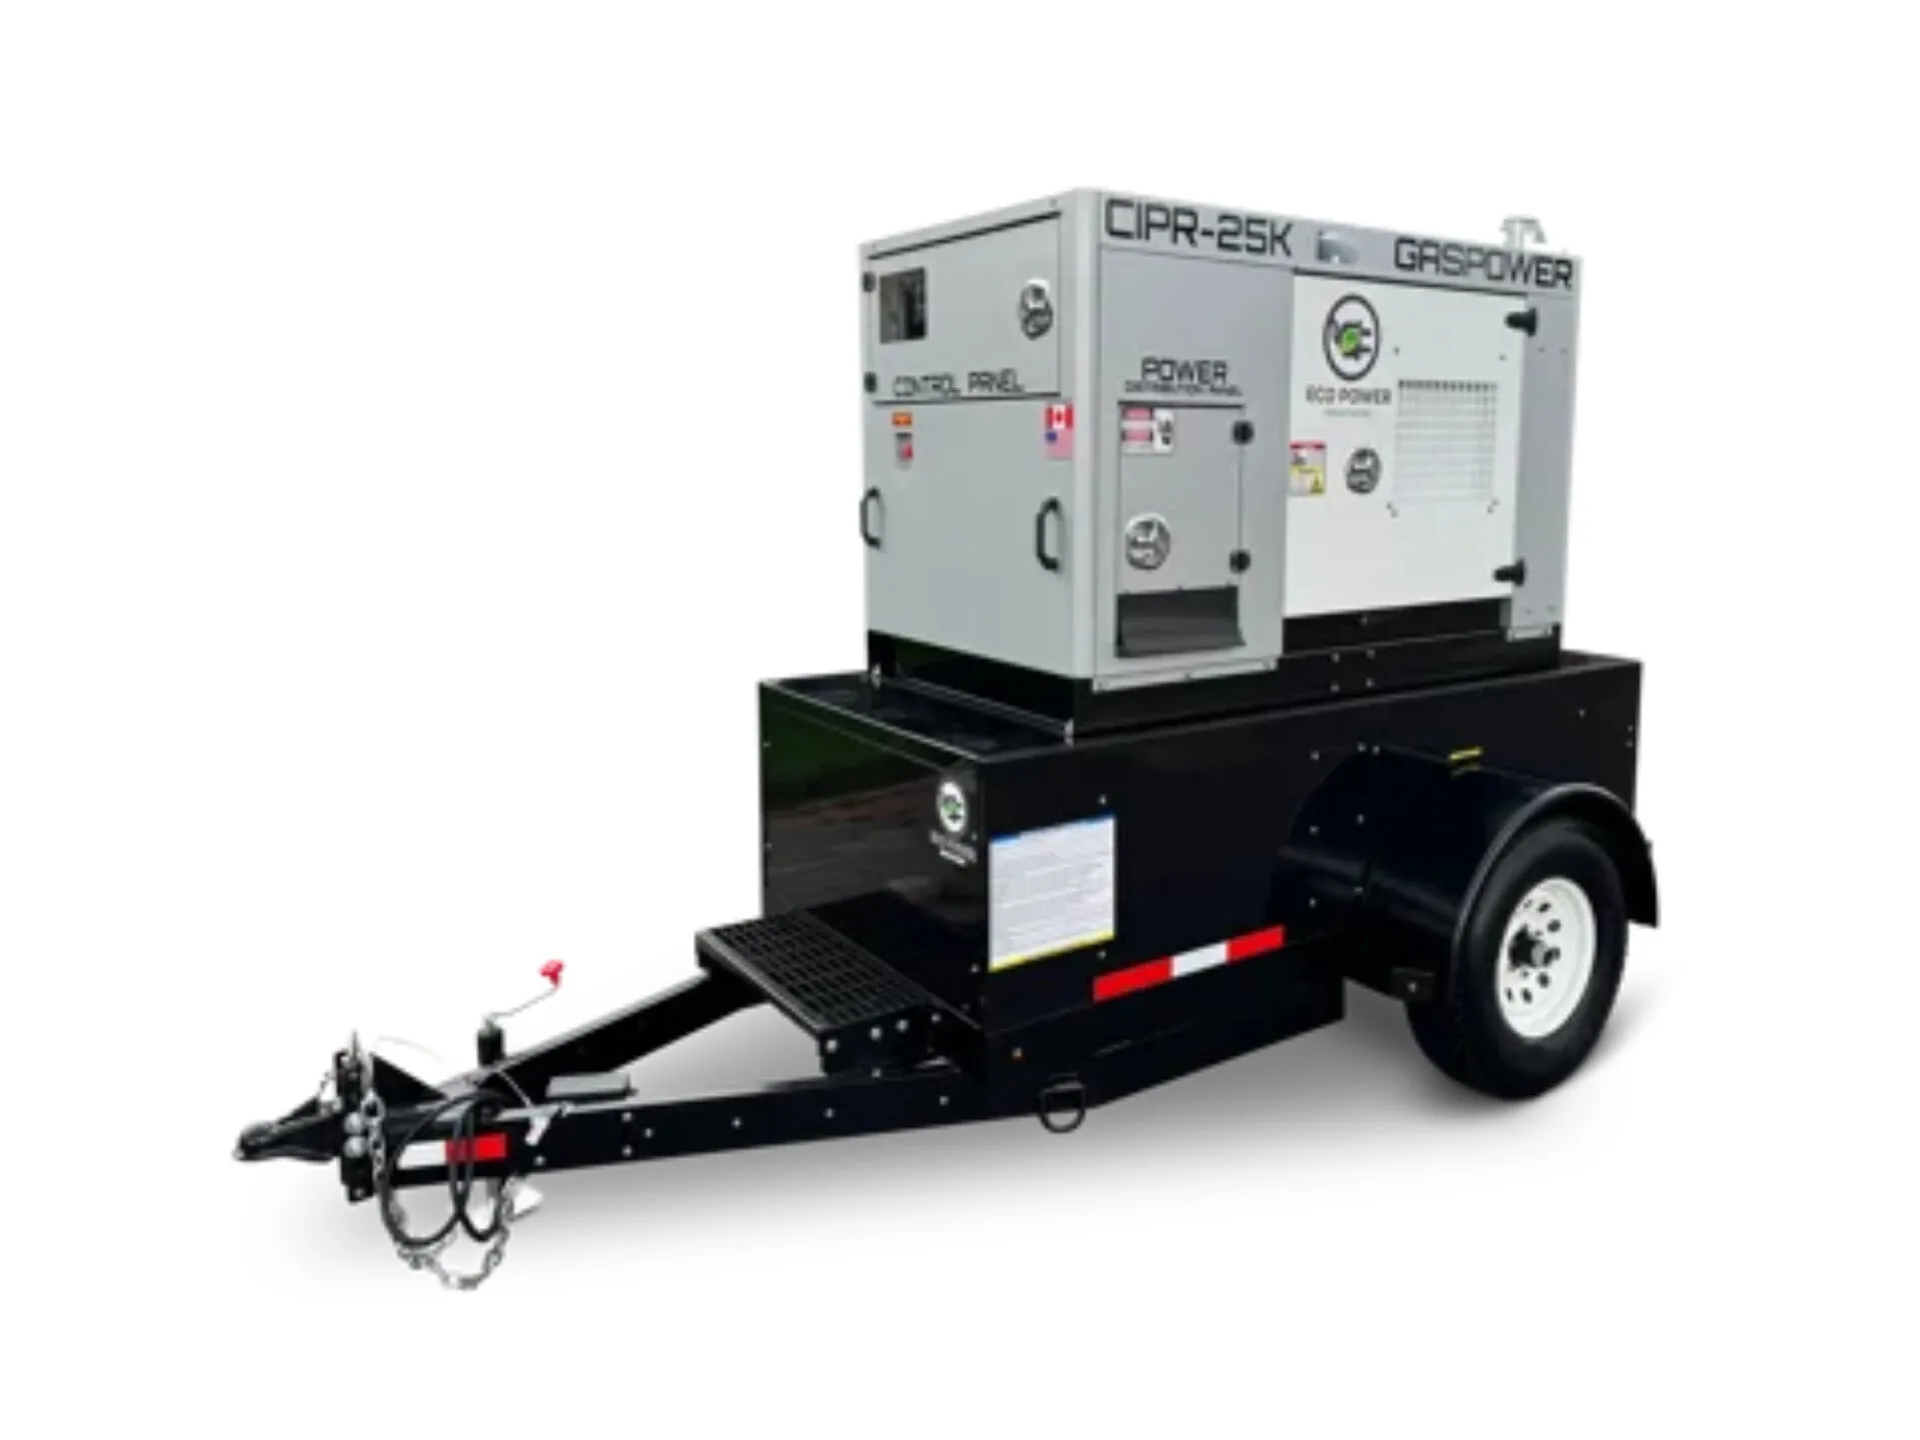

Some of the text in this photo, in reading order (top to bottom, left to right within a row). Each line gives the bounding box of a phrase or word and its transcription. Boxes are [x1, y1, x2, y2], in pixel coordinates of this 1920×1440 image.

[1105, 198, 1293, 257] CIPR-25K
[1394, 237, 1574, 290] GASPOWER
[893, 368, 1024, 399] CONTROL PANEL
[1141, 357, 1227, 385] POWER
[1305, 385, 1393, 406] ECO POWER
